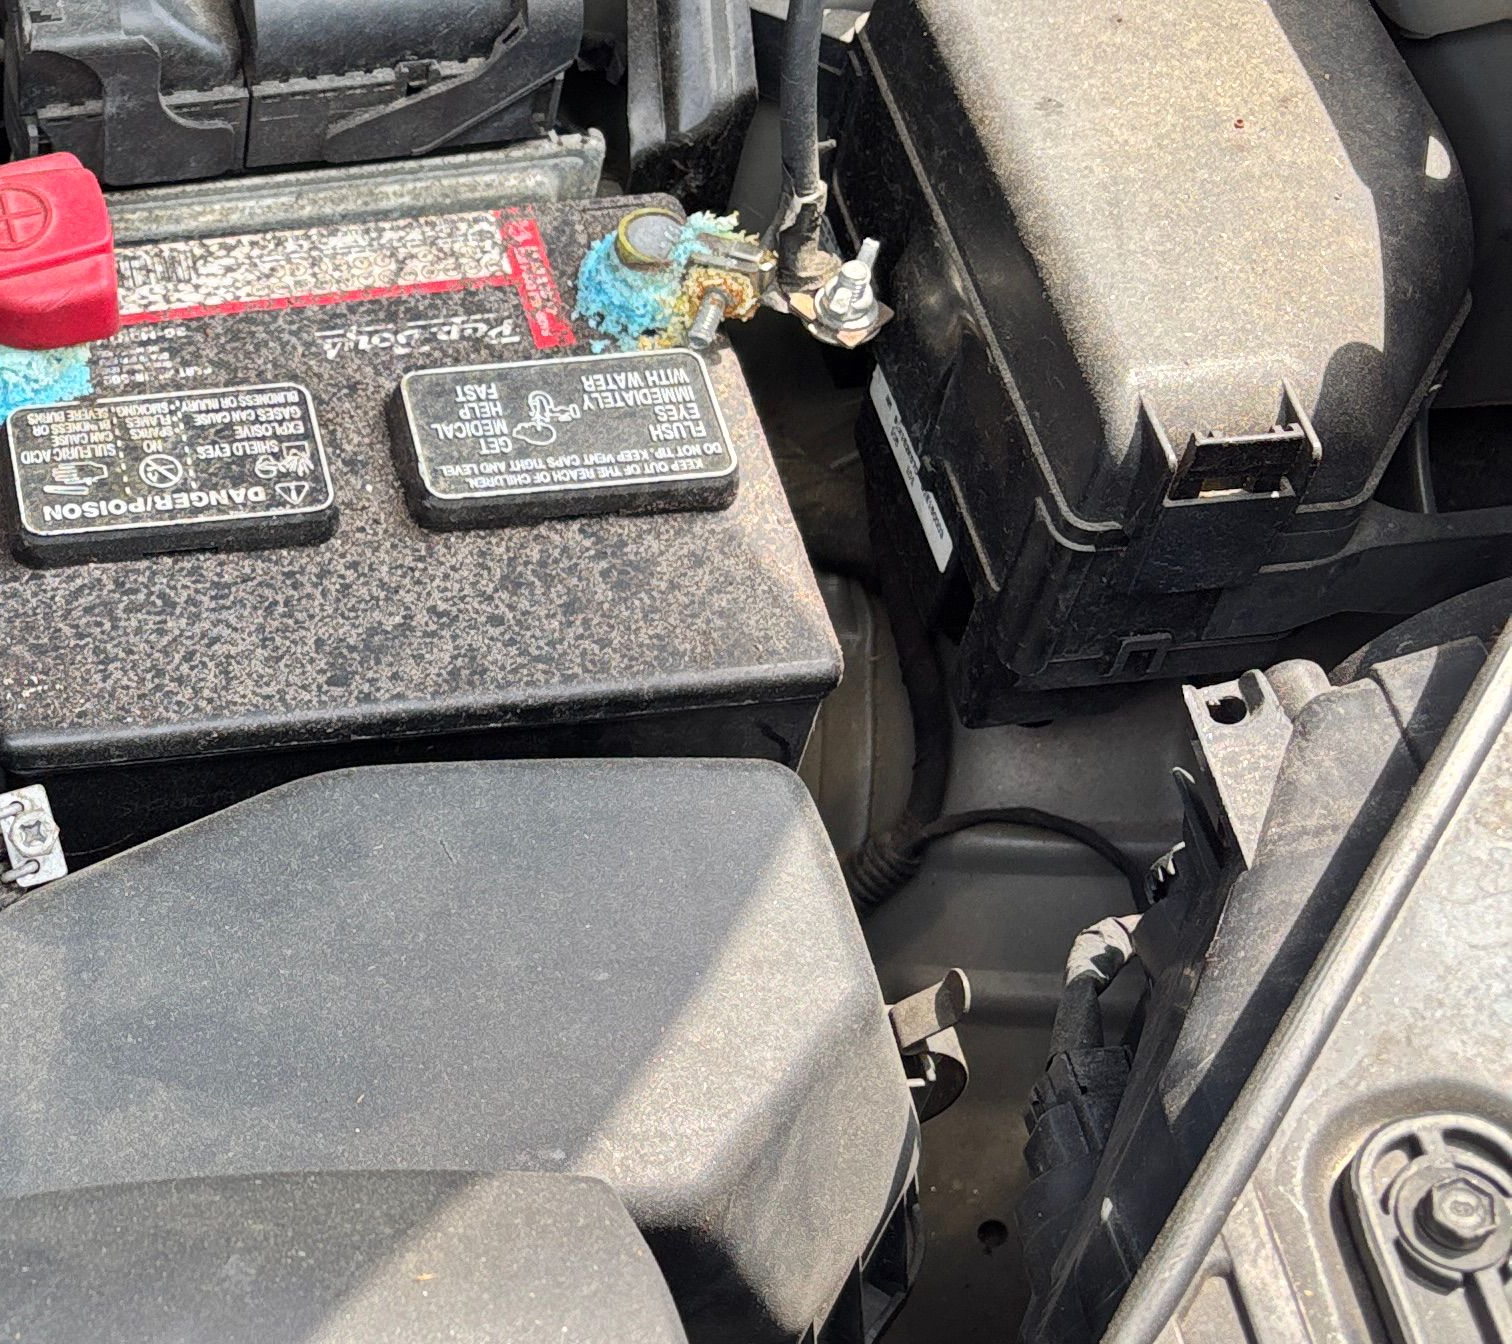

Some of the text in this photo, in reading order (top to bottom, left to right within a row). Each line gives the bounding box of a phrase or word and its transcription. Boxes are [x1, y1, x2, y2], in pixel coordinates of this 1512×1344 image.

[581, 368, 689, 392] WITH WATER
[238, 391, 299, 407] BLINDNESS
[455, 382, 498, 402] FAST
[583, 385, 695, 410] IMMEDIATELY
[220, 397, 237, 408] OR
[27, 408, 108, 425] SEVERE BURNS
[192, 405, 302, 426] GASES CAN CAUSE
[459, 401, 503, 419] HELP
[654, 402, 700, 421] EYES
[125, 414, 171, 428] FLAMES
[32, 425, 49, 436] OR
[129, 426, 174, 440] SPARKS
[233, 420, 305, 439] EXPLOSIVE
[430, 419, 508, 439] MEDICAL
[648, 420, 706, 441] FLUSH
[51, 431, 114, 447] CAN CAUSE
[143, 440, 162, 452] NO
[478, 436, 513, 454] GET
[21, 444, 117, 464] SULFURIC ACID
[196, 440, 280, 459] SHIELD EYES
[649, 447, 672, 458] TIP.
[675, 444, 701, 457] NOT
[703, 442, 722, 453] DO
[547, 455, 581, 467] CAPS
[582, 452, 615, 465] VENT
[617, 449, 649, 461] KEEP
[479, 461, 506, 473] AND
[509, 459, 546, 471] TIGHT
[623, 464, 640, 475] OF
[643, 462, 669, 473] OUT
[670, 458, 704, 471] KEEP
[532, 471, 551, 483] OF
[551, 468, 595, 482] REACH
[597, 466, 623, 478] THE
[44, 487, 266, 520] DANGER/POISON
